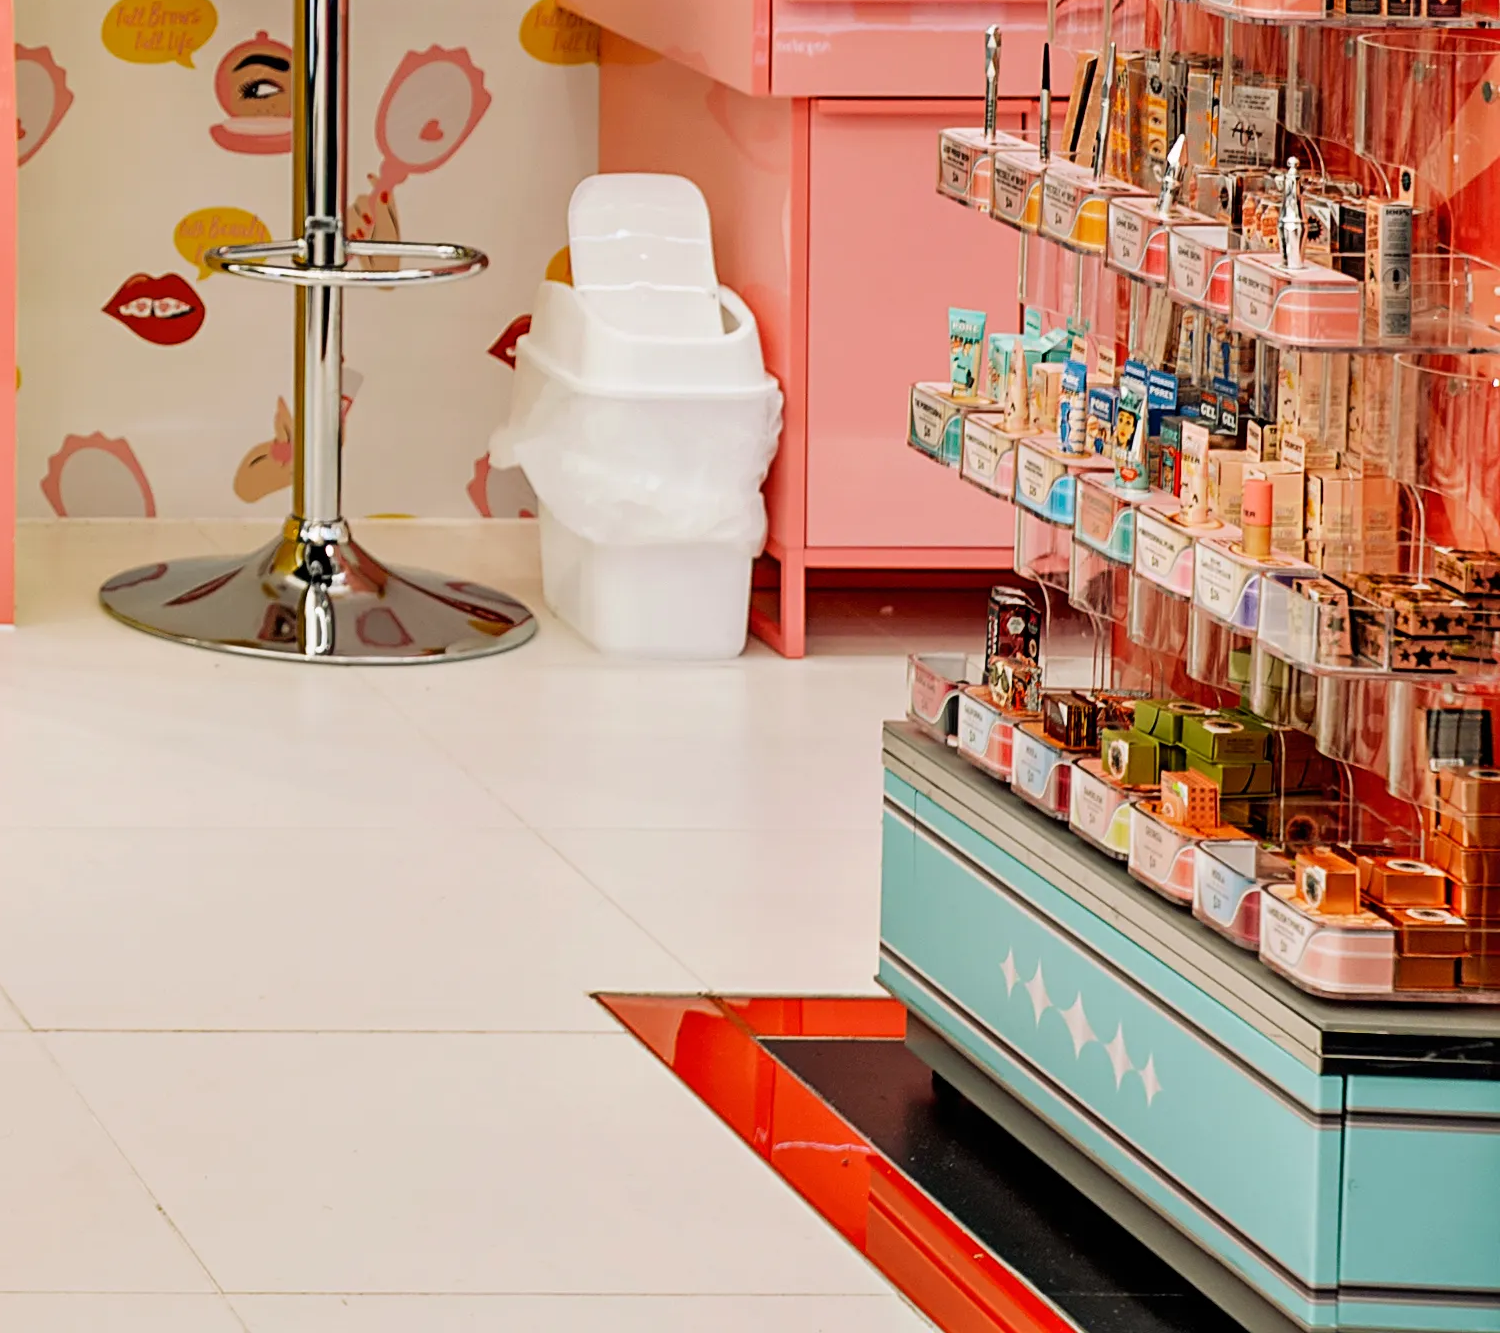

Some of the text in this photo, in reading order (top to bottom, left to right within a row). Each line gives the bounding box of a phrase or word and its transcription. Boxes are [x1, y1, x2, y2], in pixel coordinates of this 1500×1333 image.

[149, 2, 202, 26] Brows
[950, 319, 980, 333] PORE
[1149, 386, 1175, 402] PORES
[1089, 398, 1111, 414] PORE
[1200, 401, 1217, 420] GEL
[1221, 409, 1237, 428] GEL
